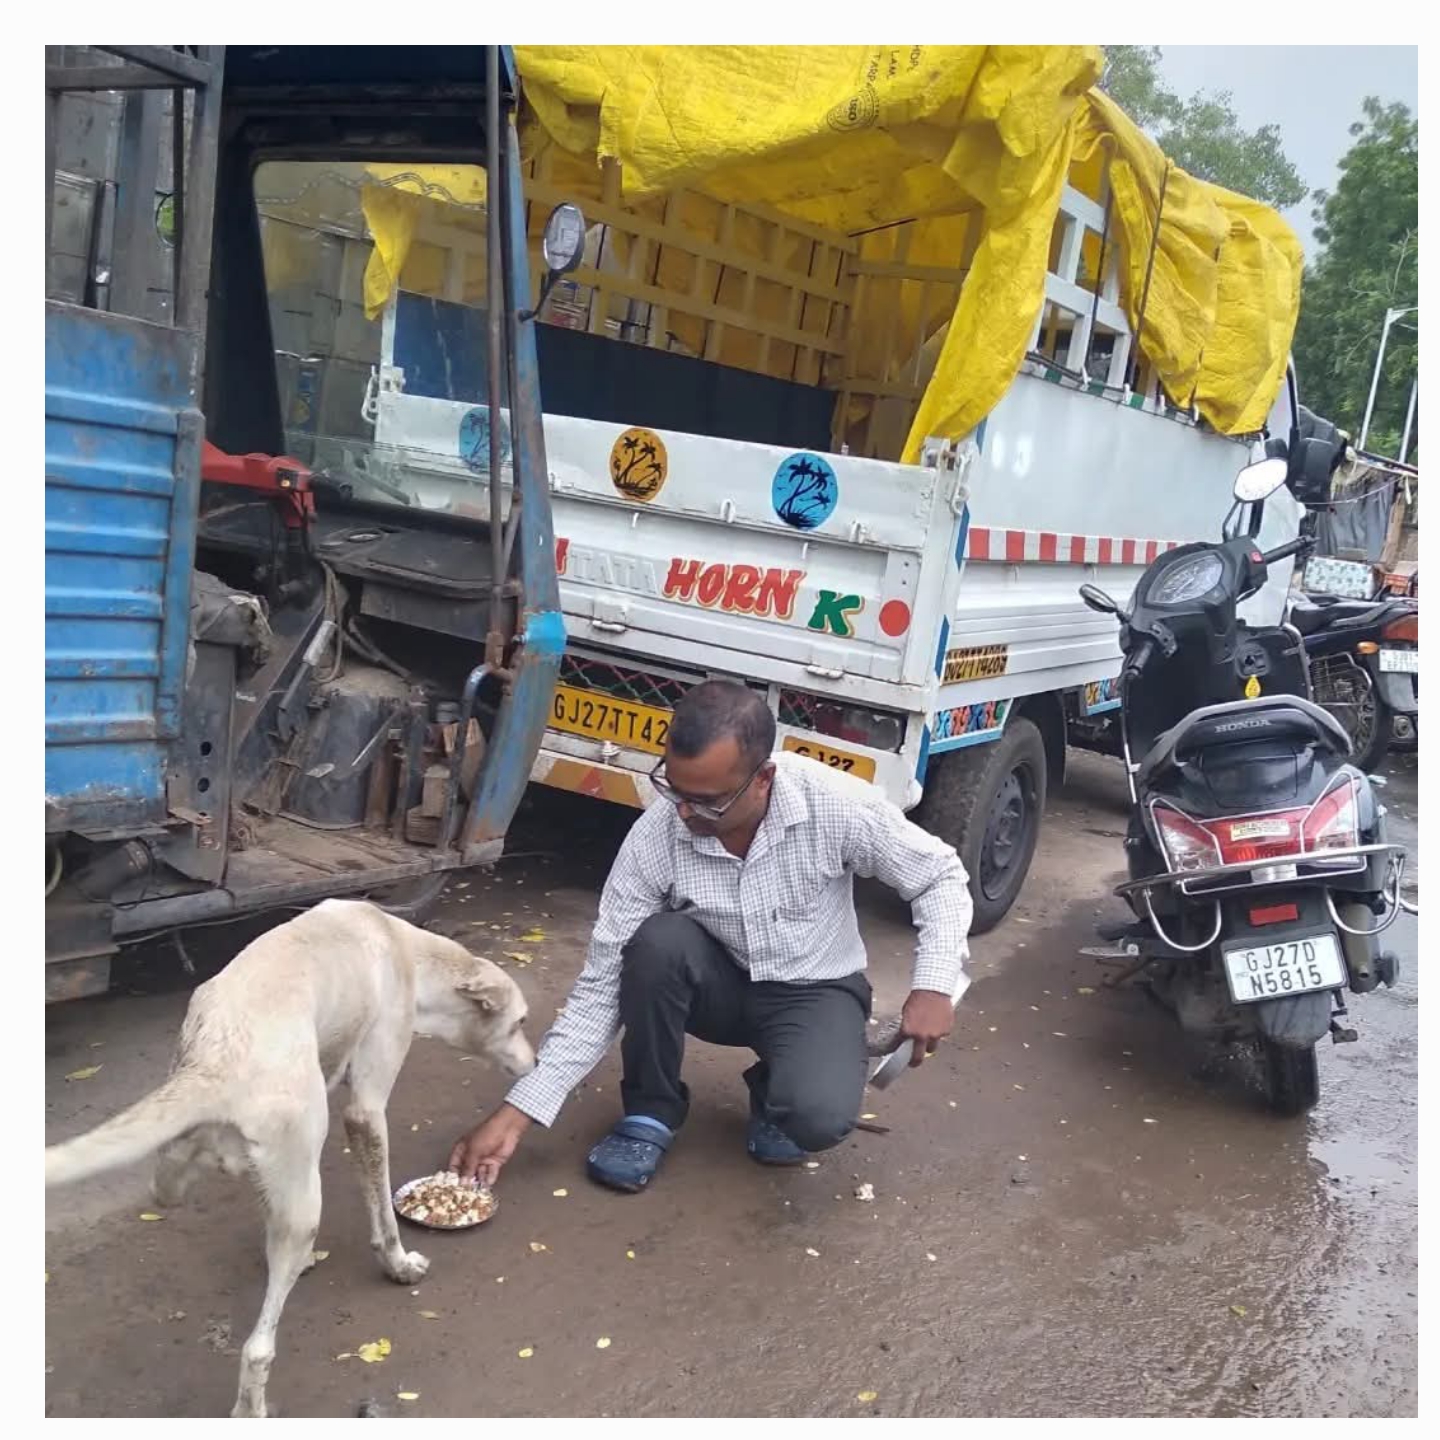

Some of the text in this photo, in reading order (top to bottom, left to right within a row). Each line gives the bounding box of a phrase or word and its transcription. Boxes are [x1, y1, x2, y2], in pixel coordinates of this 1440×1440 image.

[662, 557, 864, 637] HORN K
[1214, 719, 1273, 733] HONDA
[1246, 942, 1315, 972] GJ27D
[1250, 964, 1323, 996] N5815
